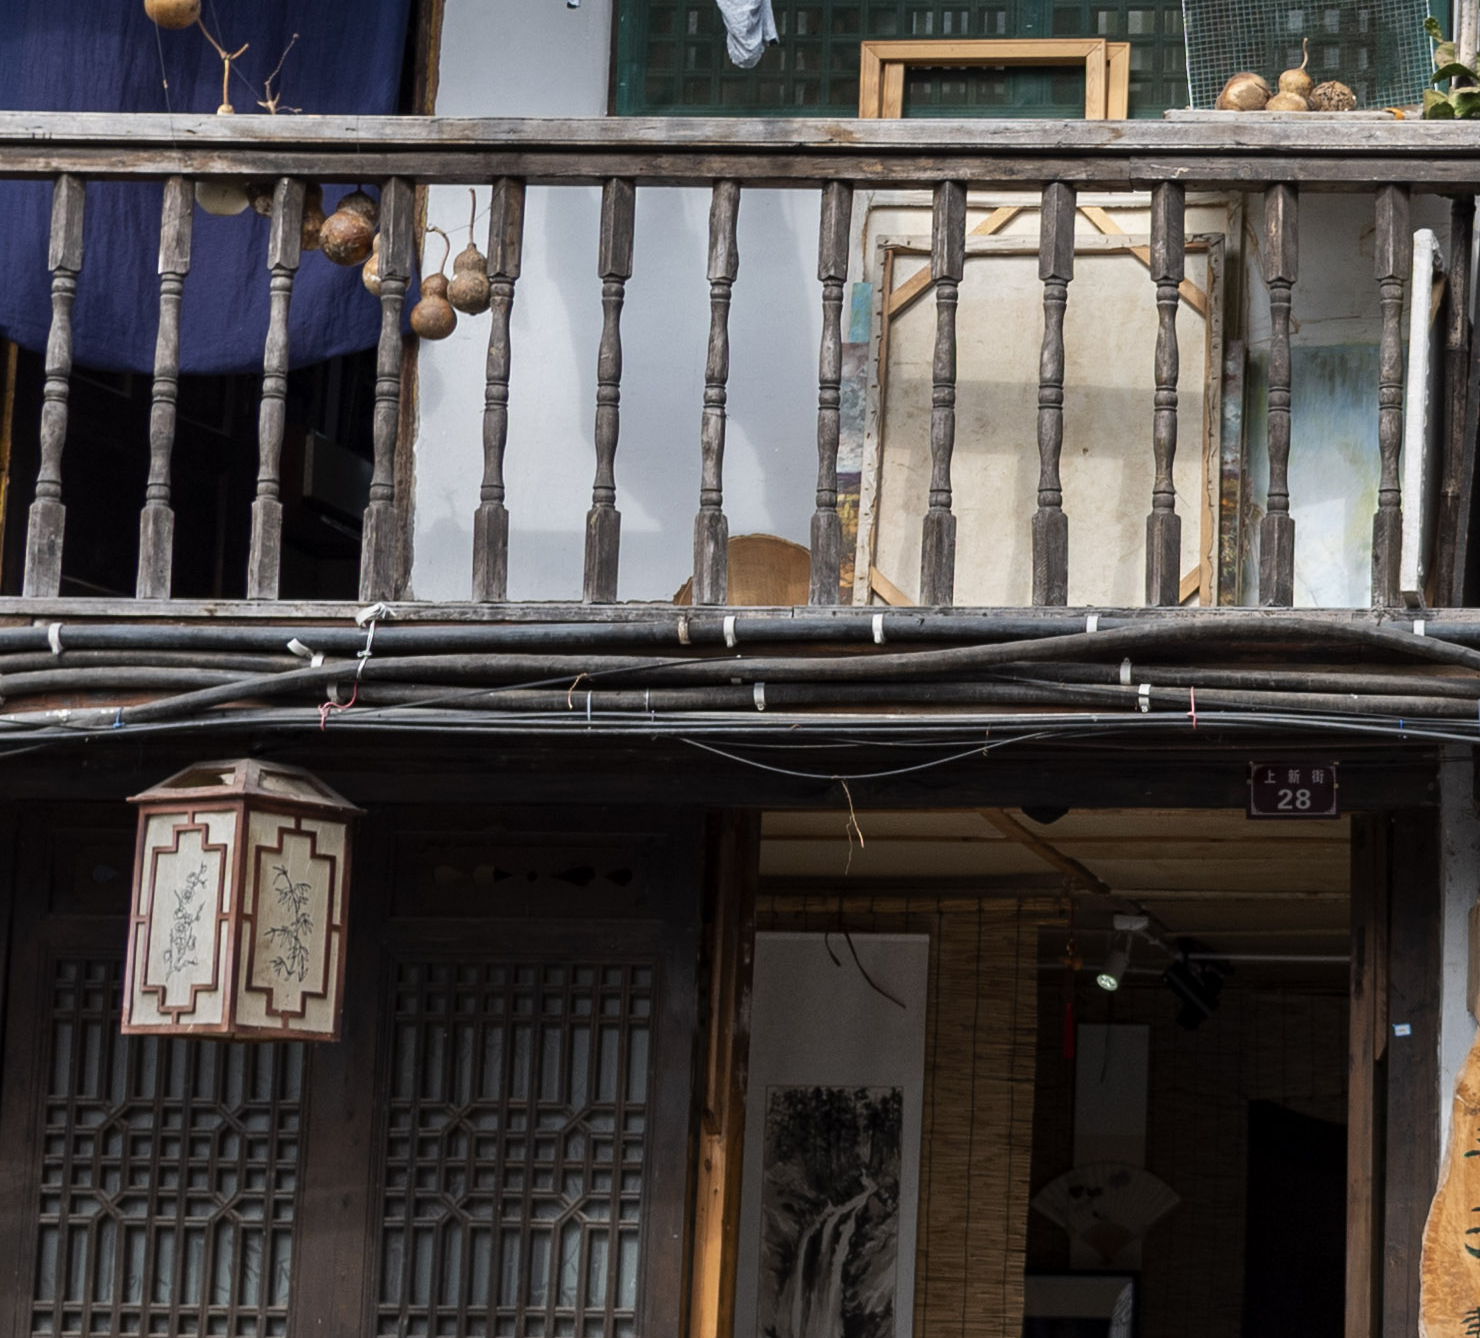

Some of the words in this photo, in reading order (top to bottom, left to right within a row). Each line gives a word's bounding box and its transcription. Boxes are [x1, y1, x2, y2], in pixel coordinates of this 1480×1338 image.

[1263, 768, 1325, 785] 上新街
[1276, 788, 1312, 811] 28
